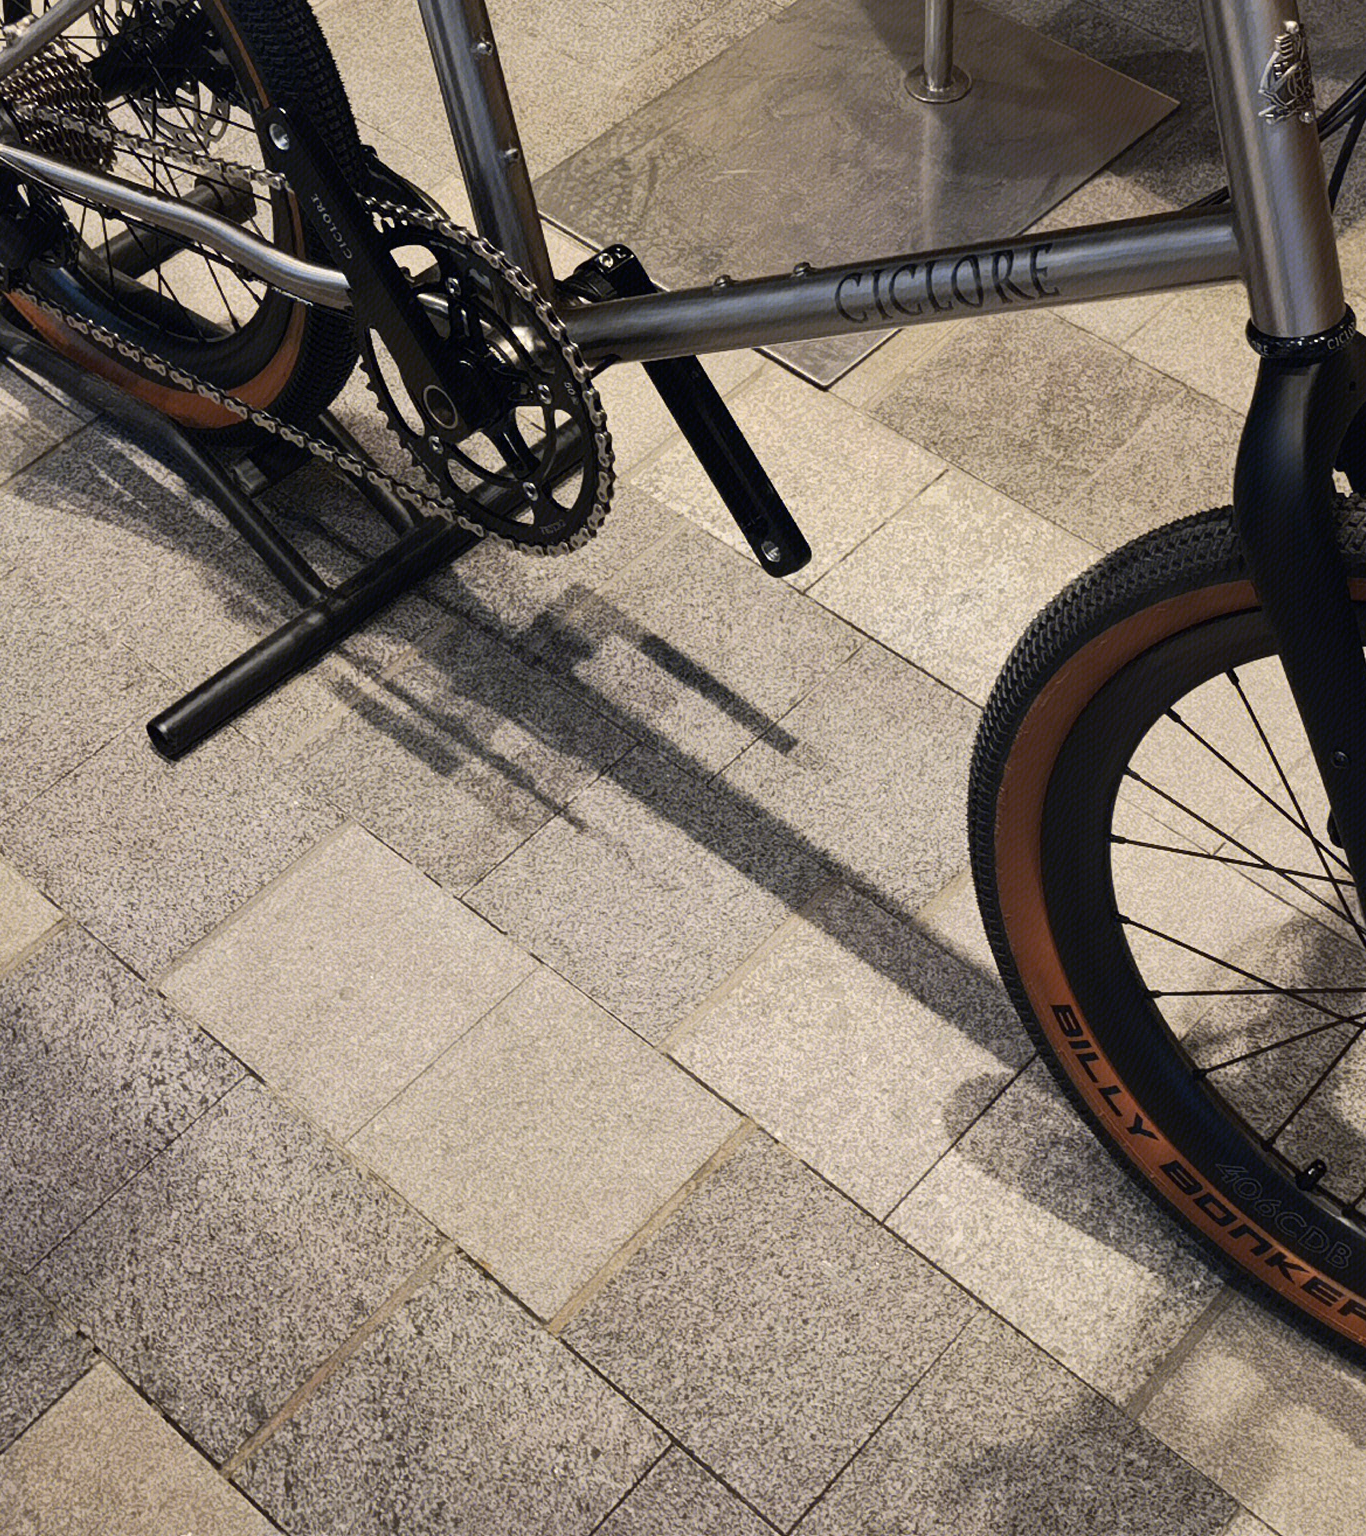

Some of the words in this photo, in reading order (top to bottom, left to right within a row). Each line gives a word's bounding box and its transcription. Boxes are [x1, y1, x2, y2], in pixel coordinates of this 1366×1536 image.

[834, 242, 1061, 324] CICLORE
[1050, 1003, 1161, 1143] BILLY
[1215, 1162, 1354, 1272] 406CDB
